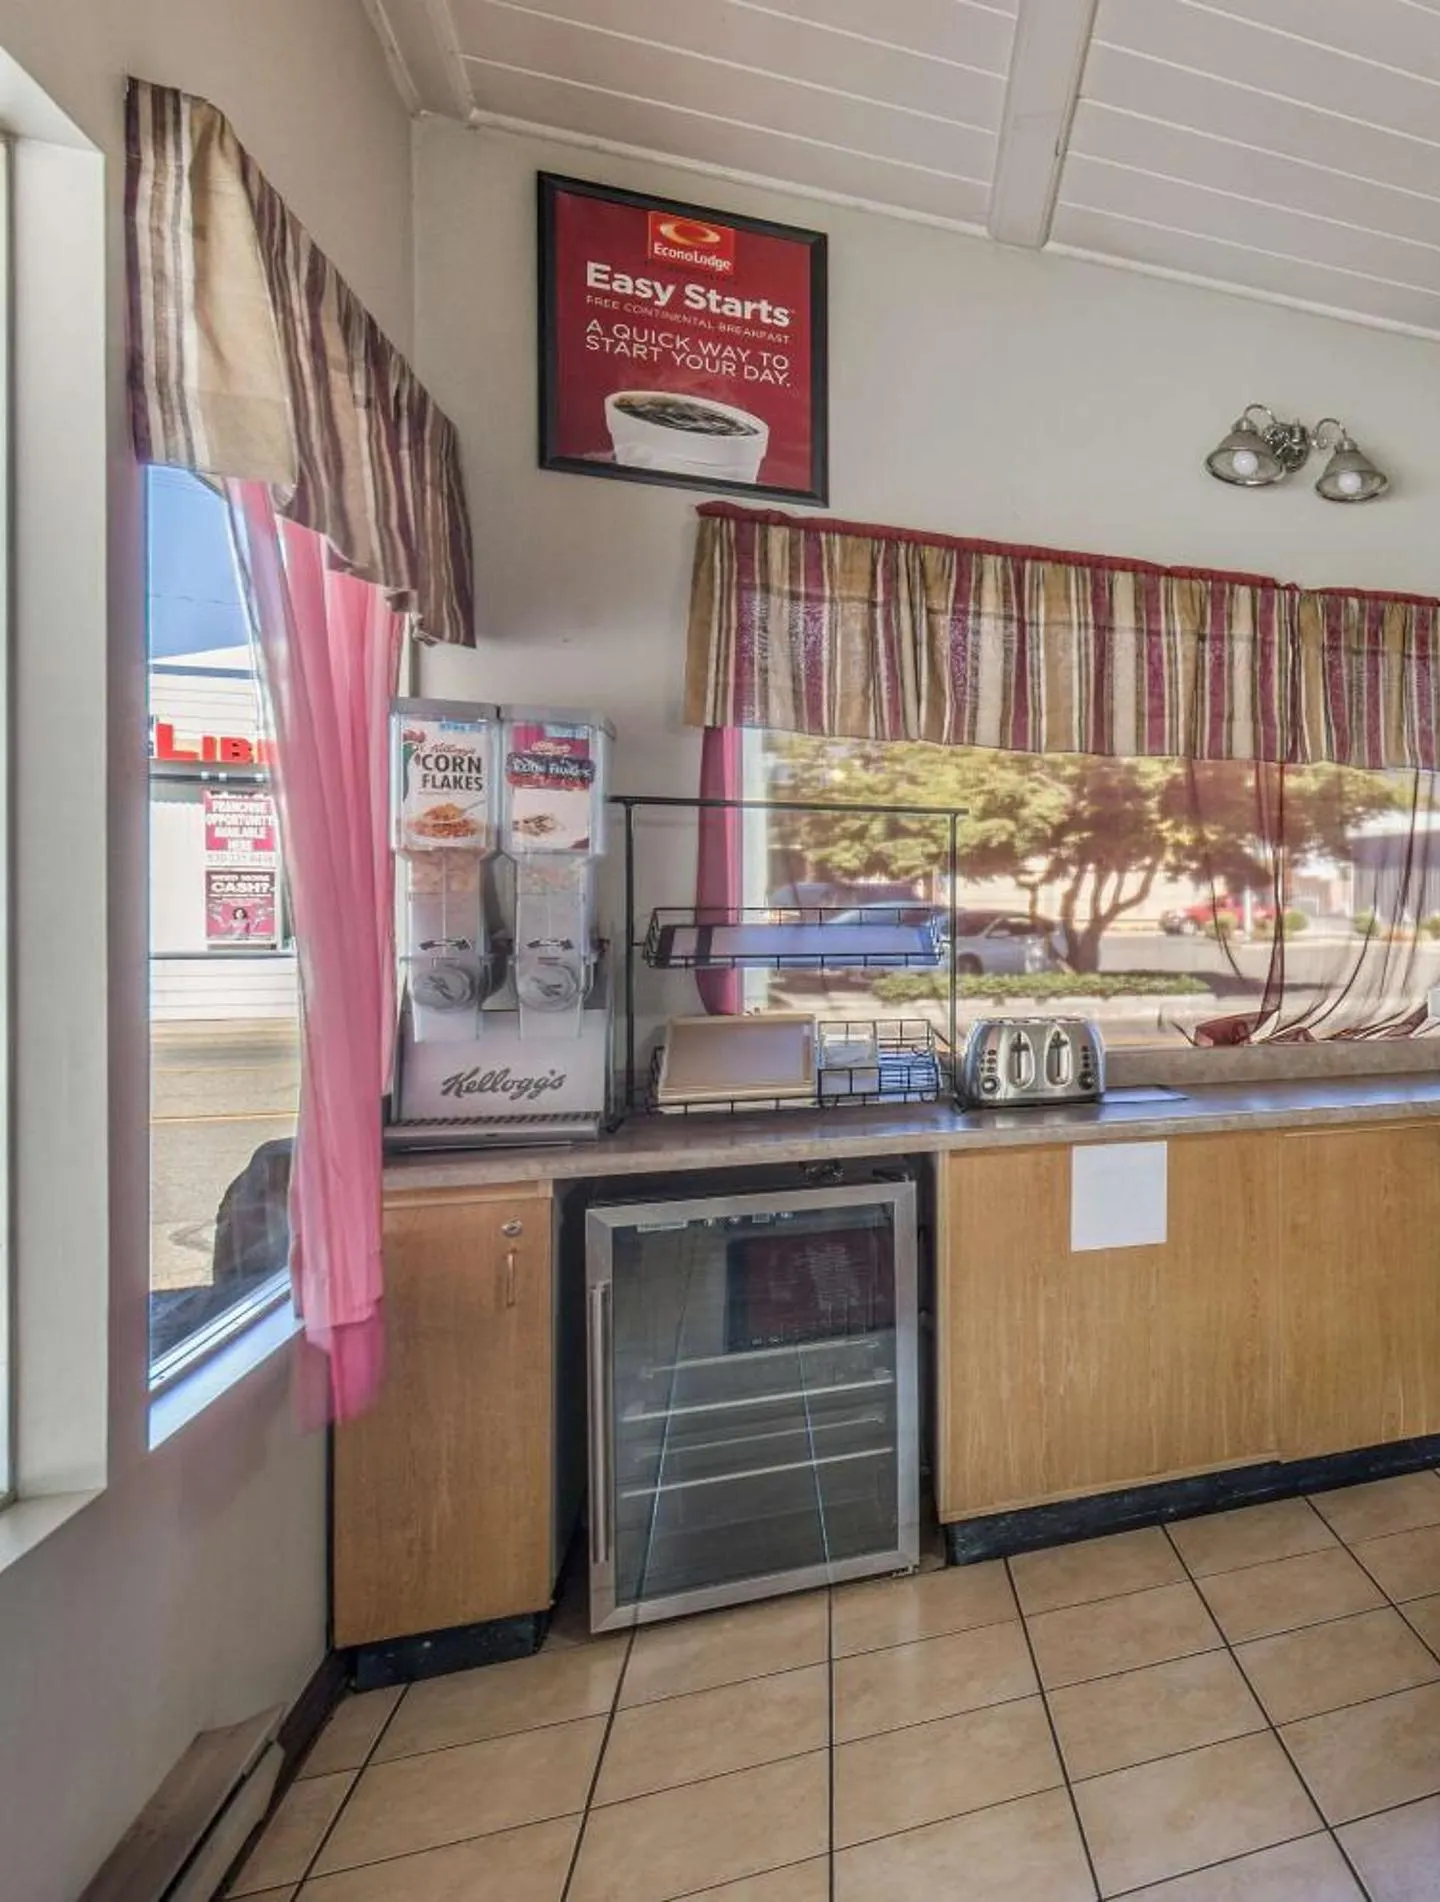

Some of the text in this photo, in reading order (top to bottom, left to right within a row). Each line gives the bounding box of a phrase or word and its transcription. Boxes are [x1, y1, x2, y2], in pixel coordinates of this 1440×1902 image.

[653, 242, 732, 271] EconoLodge
[586, 261, 790, 328] Easy Starts
[586, 295, 791, 344] FREE CONTINENTAL BREAKFAST
[586, 318, 789, 370] A QUICK WAY TO
[586, 335, 791, 388] START YOUR DAY.
[421, 753, 483, 774] CORN
[421, 773, 484, 792] FLAKES
[211, 881, 271, 894] CASH?
[441, 1066, 568, 1101] Kellogg's
